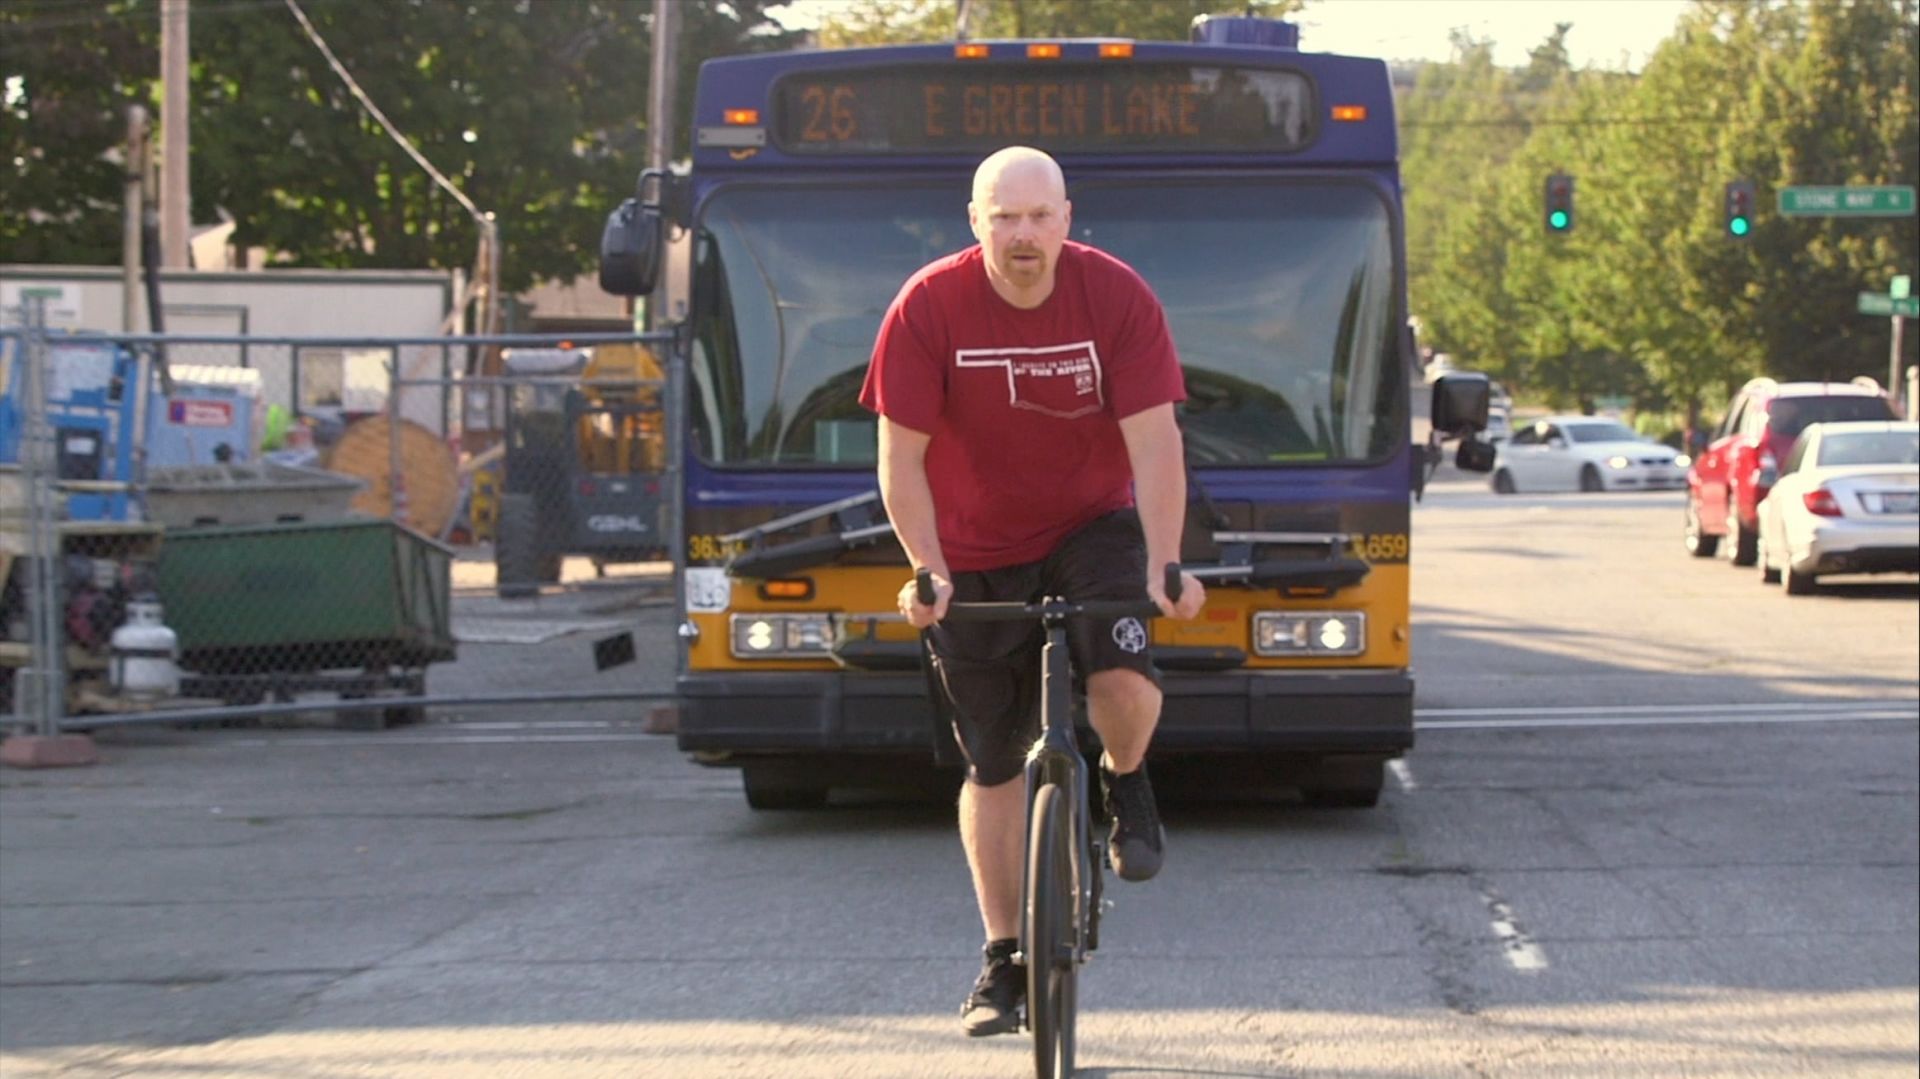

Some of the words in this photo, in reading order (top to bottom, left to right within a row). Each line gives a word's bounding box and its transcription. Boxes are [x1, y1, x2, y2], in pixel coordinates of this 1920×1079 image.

[801, 84, 857, 141] 26
[924, 83, 945, 138] E
[963, 83, 1087, 138] GREEN
[1103, 82, 1200, 137] LAKE
[1794, 192, 1837, 209] STONE
[1845, 192, 1874, 208] WAY
[1030, 368, 1053, 377] THE
[1056, 364, 1091, 376] RIVER
